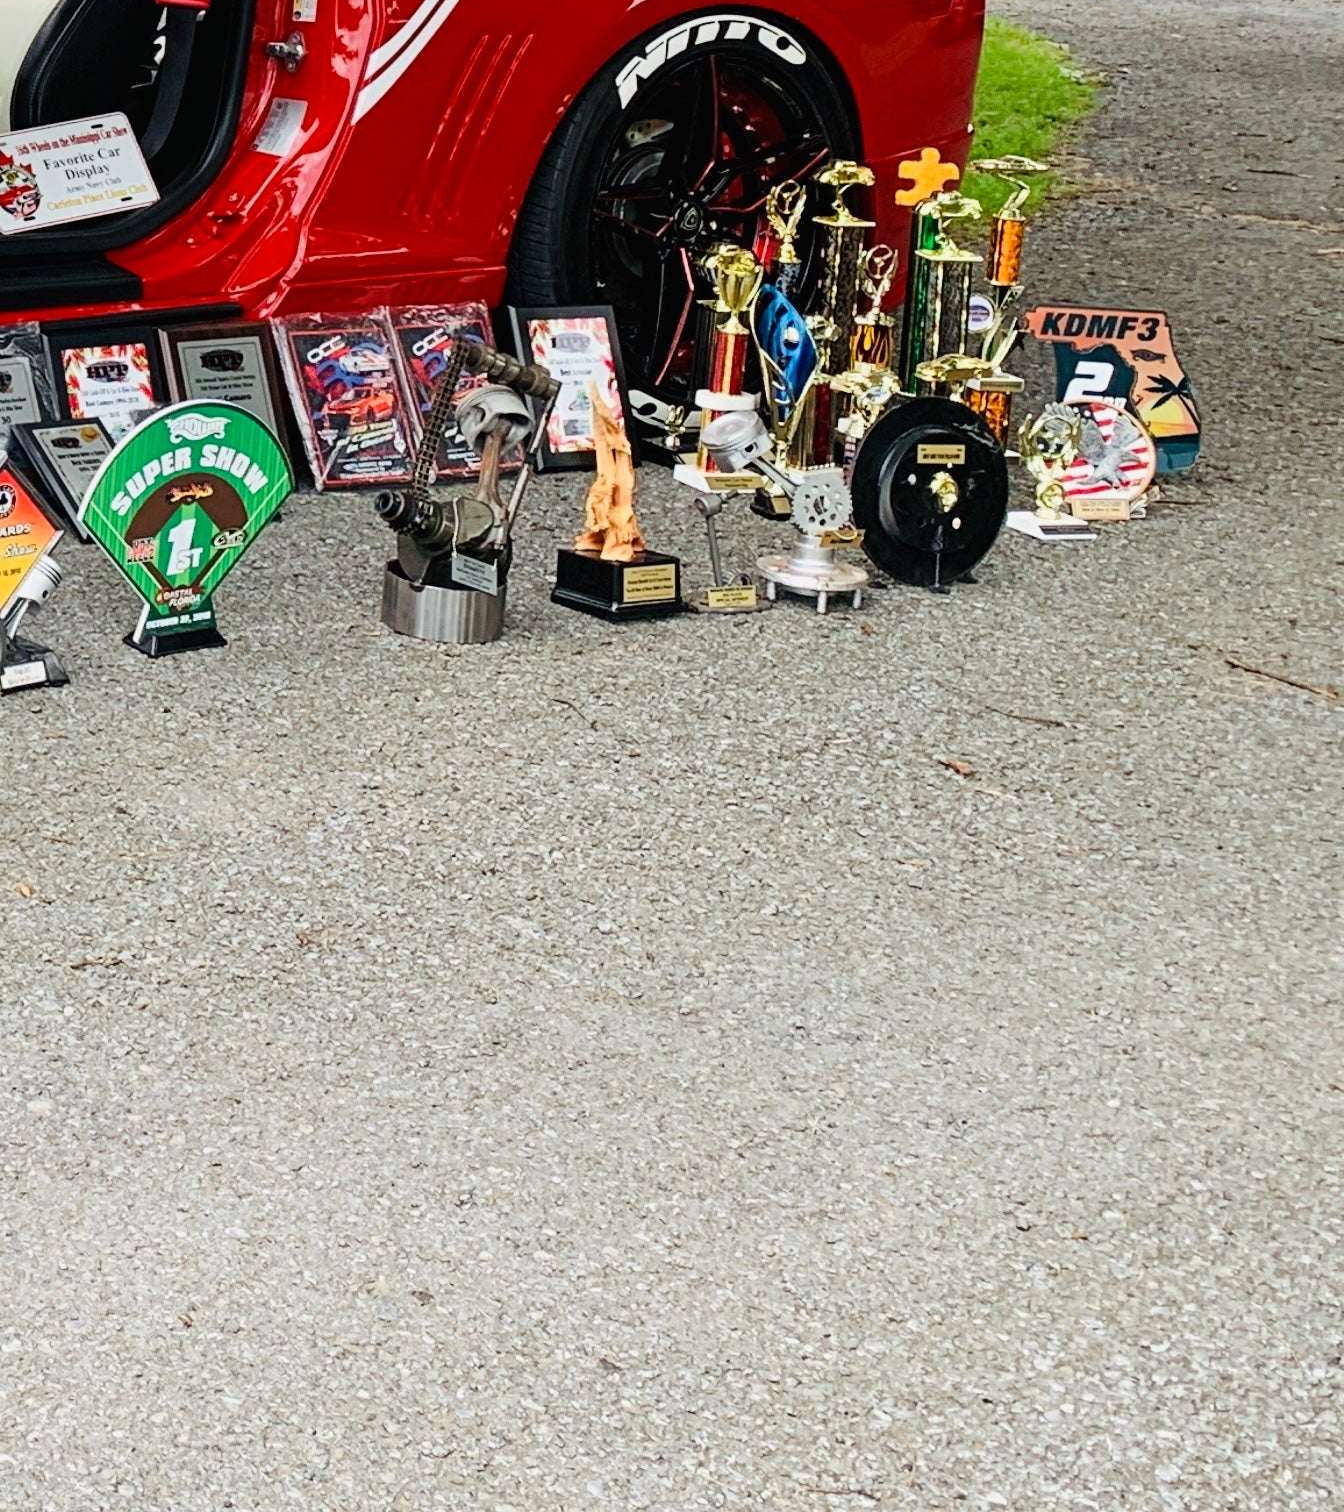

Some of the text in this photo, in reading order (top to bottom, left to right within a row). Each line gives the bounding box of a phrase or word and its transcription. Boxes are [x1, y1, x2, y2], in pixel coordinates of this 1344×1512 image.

[615, 14, 806, 110] NITTO
[42, 147, 121, 170] Favorite Car
[65, 163, 111, 180] Display
[86, 181, 104, 189] Navy
[1041, 313, 1160, 341] KDMF3
[1, 416, 12, 425] 30
[111, 444, 269, 516] SUPER SHOW
[3, 543, 37, 559] Show
